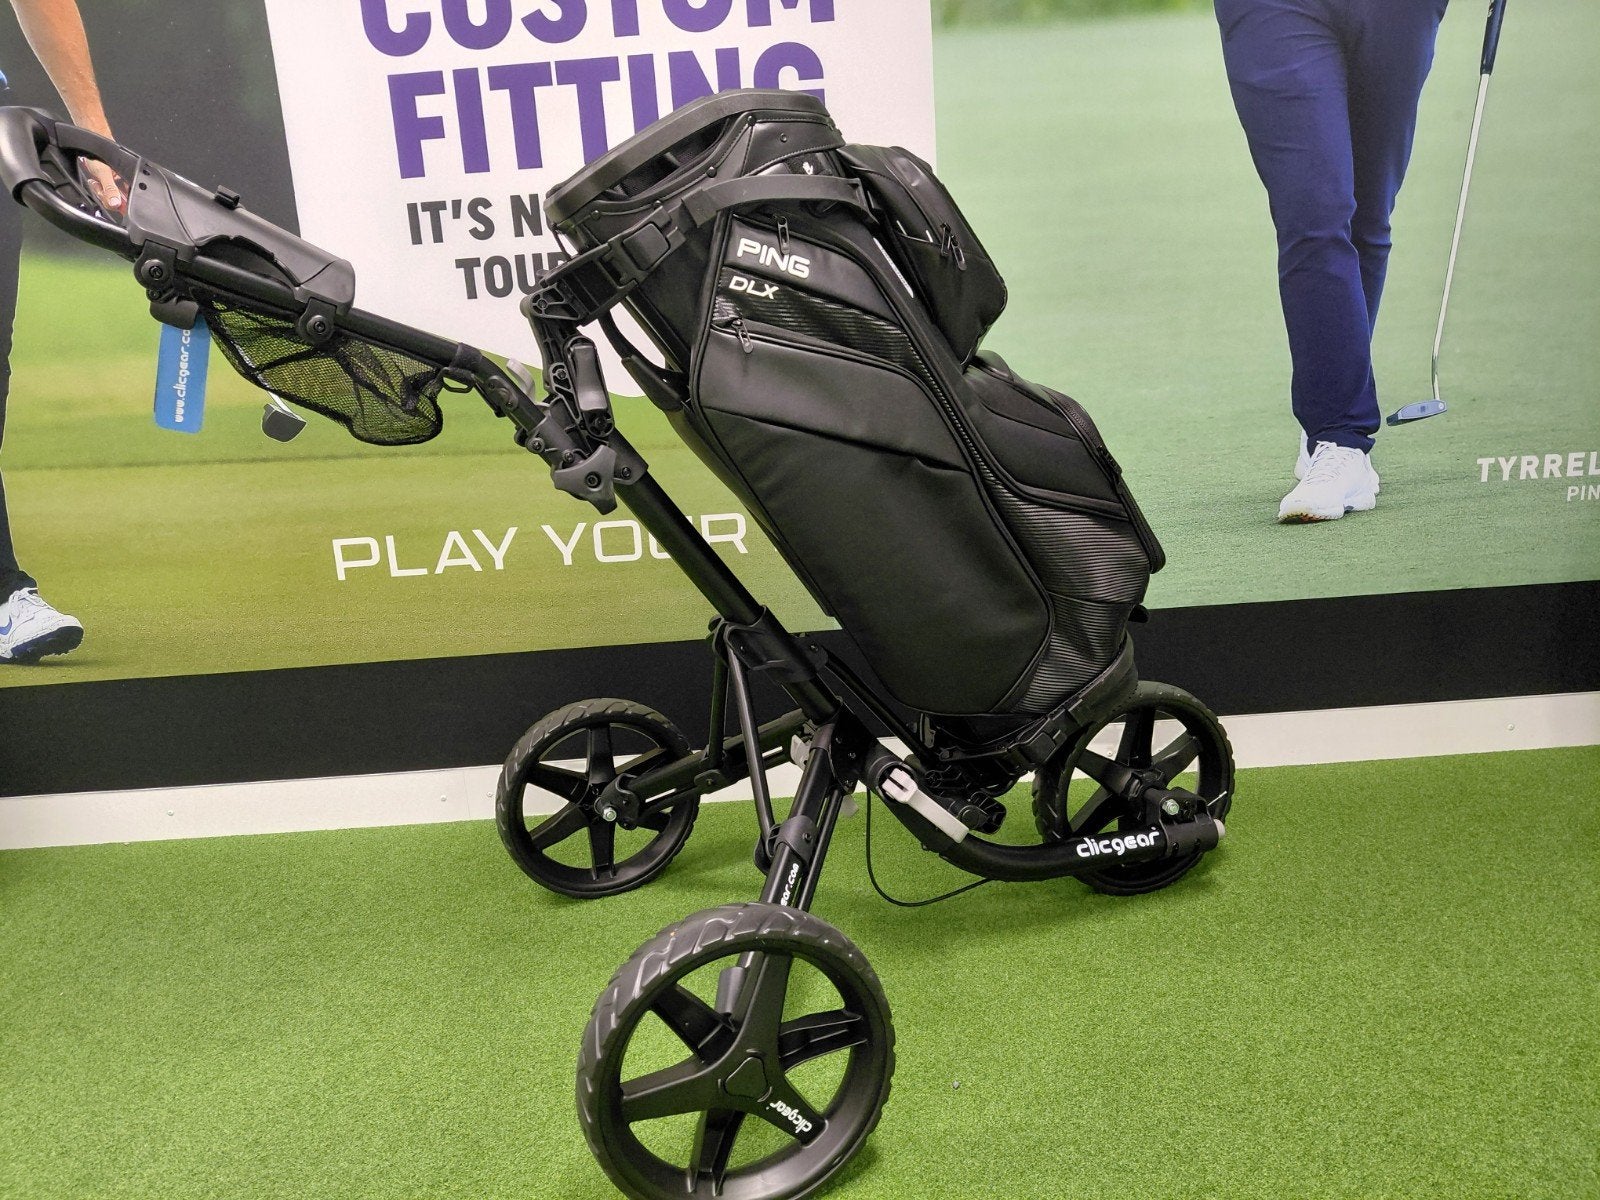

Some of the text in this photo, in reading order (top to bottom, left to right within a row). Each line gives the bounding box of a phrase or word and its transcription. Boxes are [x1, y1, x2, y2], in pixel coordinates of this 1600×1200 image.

[407, 194, 552, 245] IT'S N
[737, 238, 810, 278] PING
[728, 275, 779, 299] DLX
[1477, 451, 1600, 482] TYRREL
[1567, 485, 1600, 501] PIN
[332, 526, 518, 580] PLAY
[1076, 828, 1159, 857] clicgear
[769, 1100, 812, 1133] clicgear
